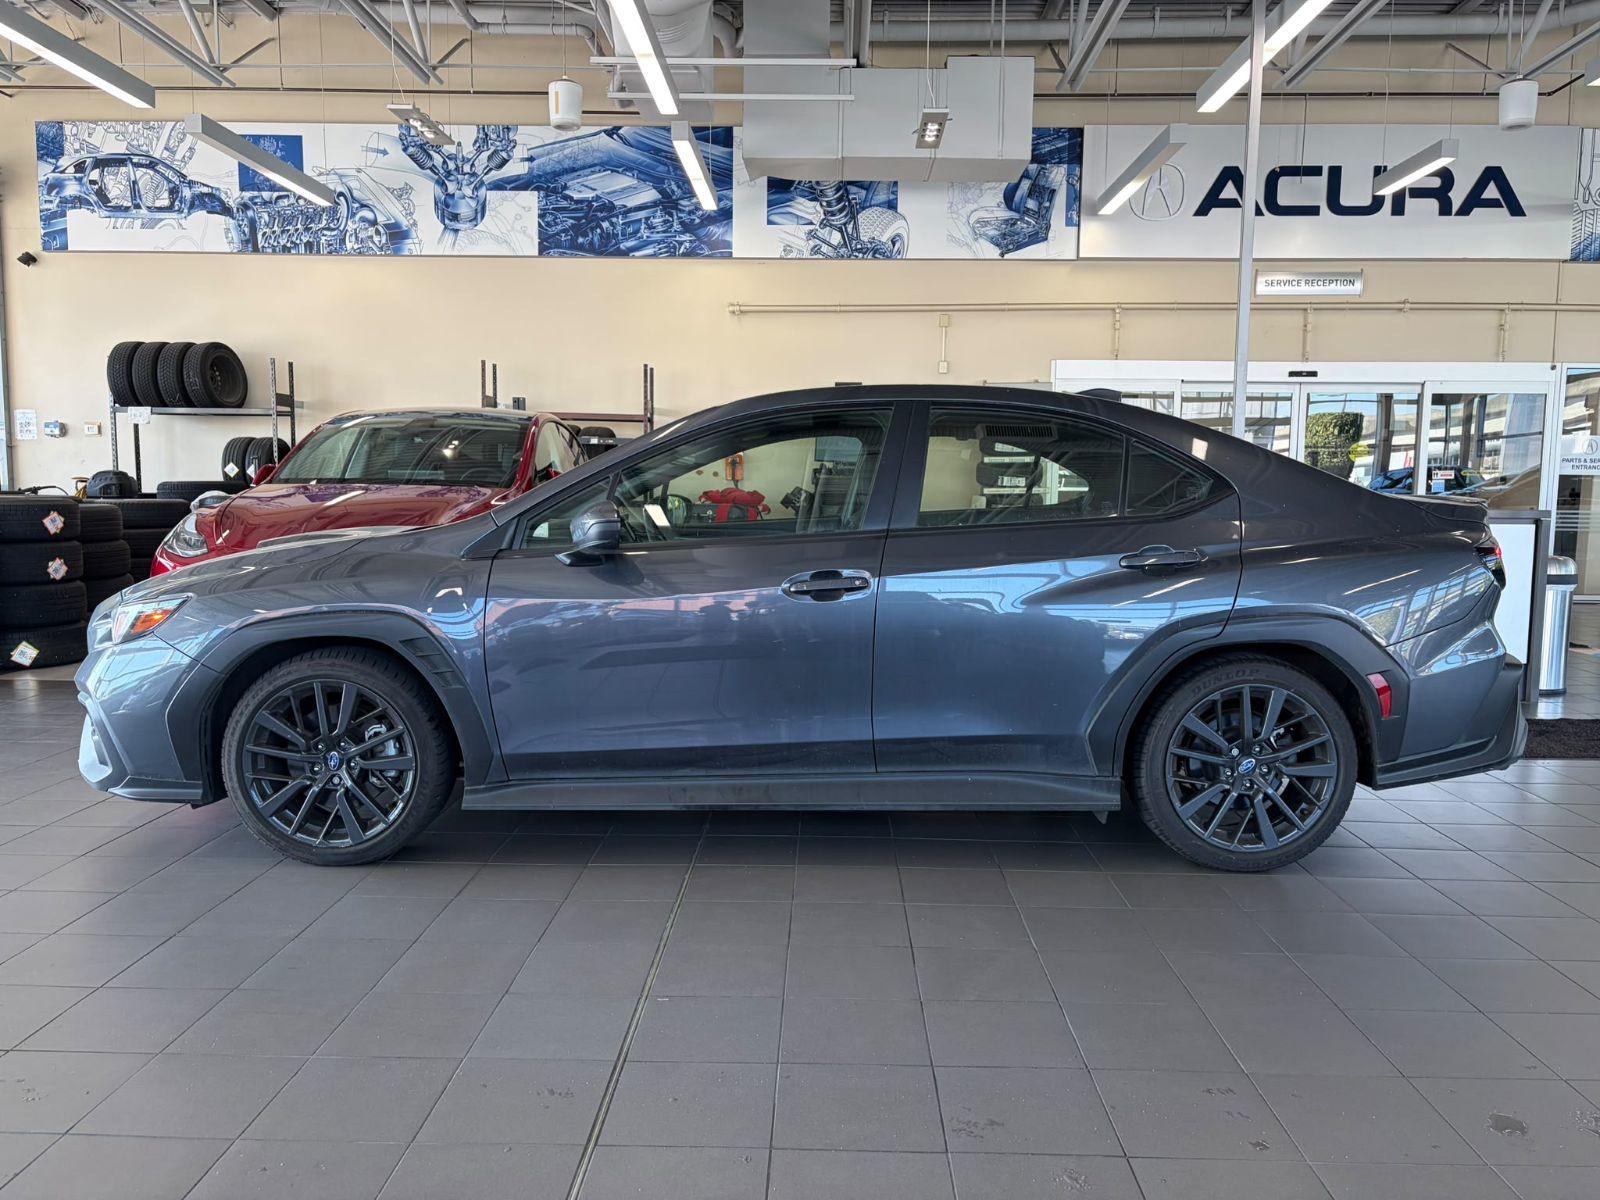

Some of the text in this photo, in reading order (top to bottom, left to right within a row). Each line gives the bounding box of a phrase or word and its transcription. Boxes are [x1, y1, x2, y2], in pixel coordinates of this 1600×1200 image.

[1192, 165, 1528, 217] ACURA
[1264, 278, 1356, 288] SERVICE RECEPTION
